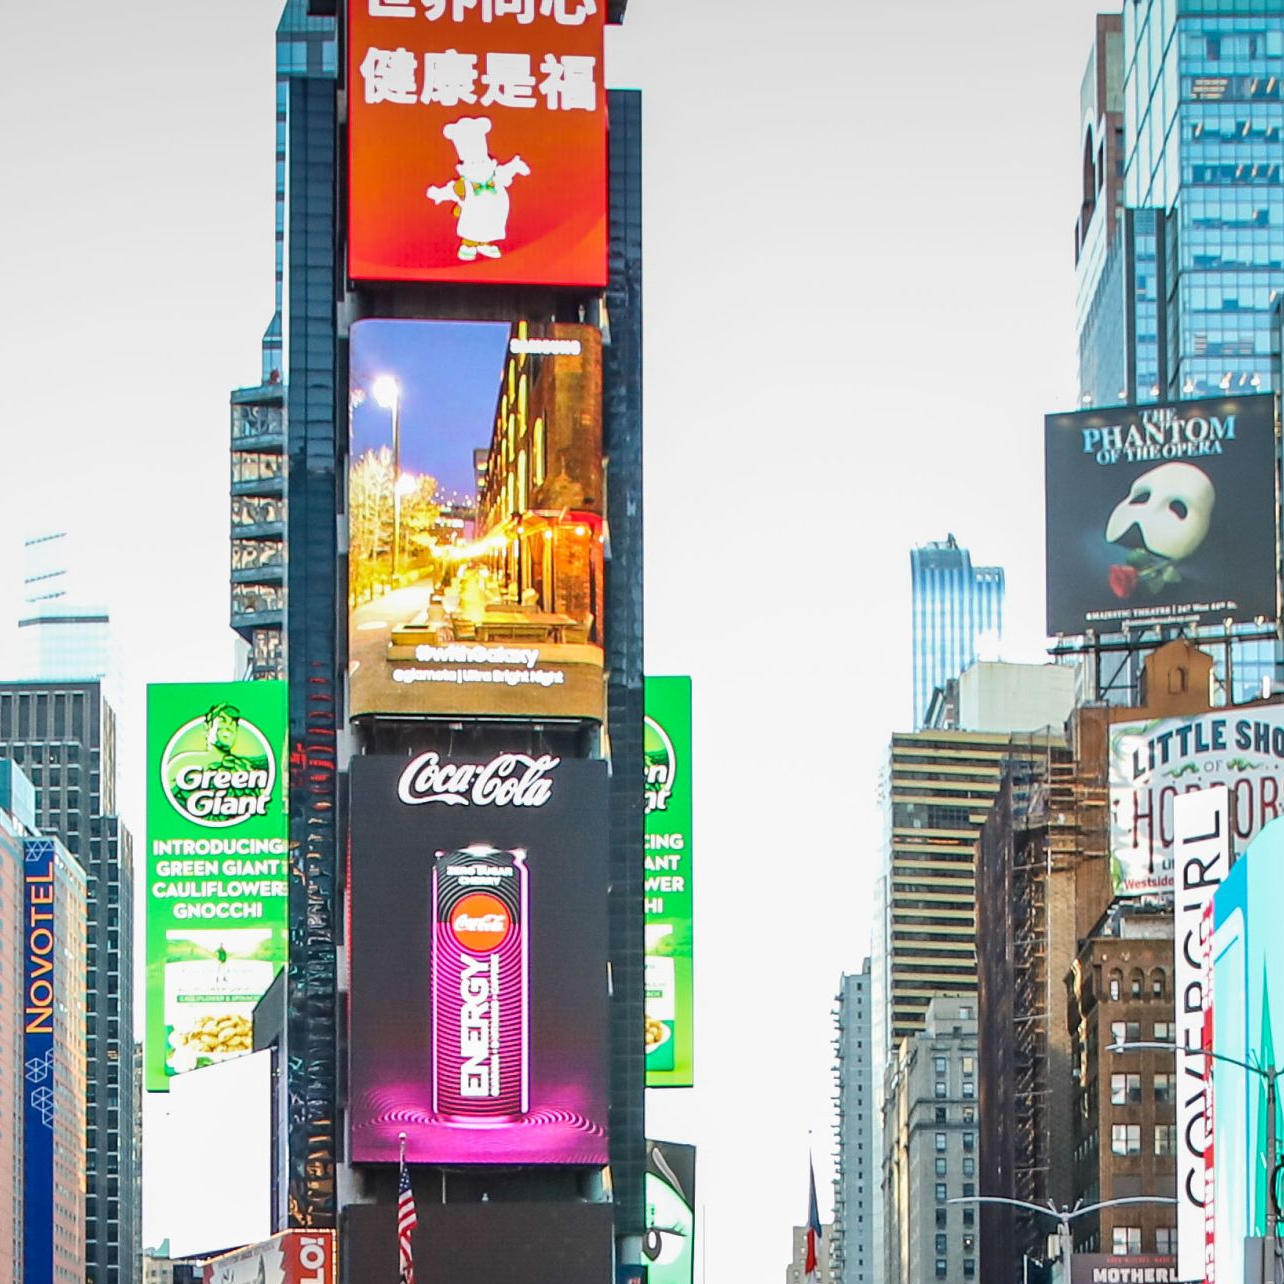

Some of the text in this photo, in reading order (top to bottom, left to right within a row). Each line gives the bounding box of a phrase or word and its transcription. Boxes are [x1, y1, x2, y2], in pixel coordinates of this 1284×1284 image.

[360, 47, 596, 111] 健康是福
[1139, 408, 1177, 426] THE
[1082, 415, 1237, 454] PHANTOM
[1096, 440, 1223, 466] OF THE OPERA
[493, 670, 525, 687] Bright
[526, 670, 565, 688] Night
[1133, 719, 1227, 780] LITTLE
[176, 766, 268, 791] Green
[398, 751, 561, 807] Coca-Cola
[1204, 761, 1222, 773] OF
[186, 790, 271, 817] Giant
[153, 839, 283, 856] INTRODUCING
[156, 860, 281, 877] GREEN GIANT
[477, 865, 514, 877] SUGAR
[152, 881, 285, 898] CAULIFLOWER
[173, 902, 263, 919] GNOCCHI
[25, 861, 54, 1034] NOVOTEL
[460, 953, 491, 1097] ENERGY
